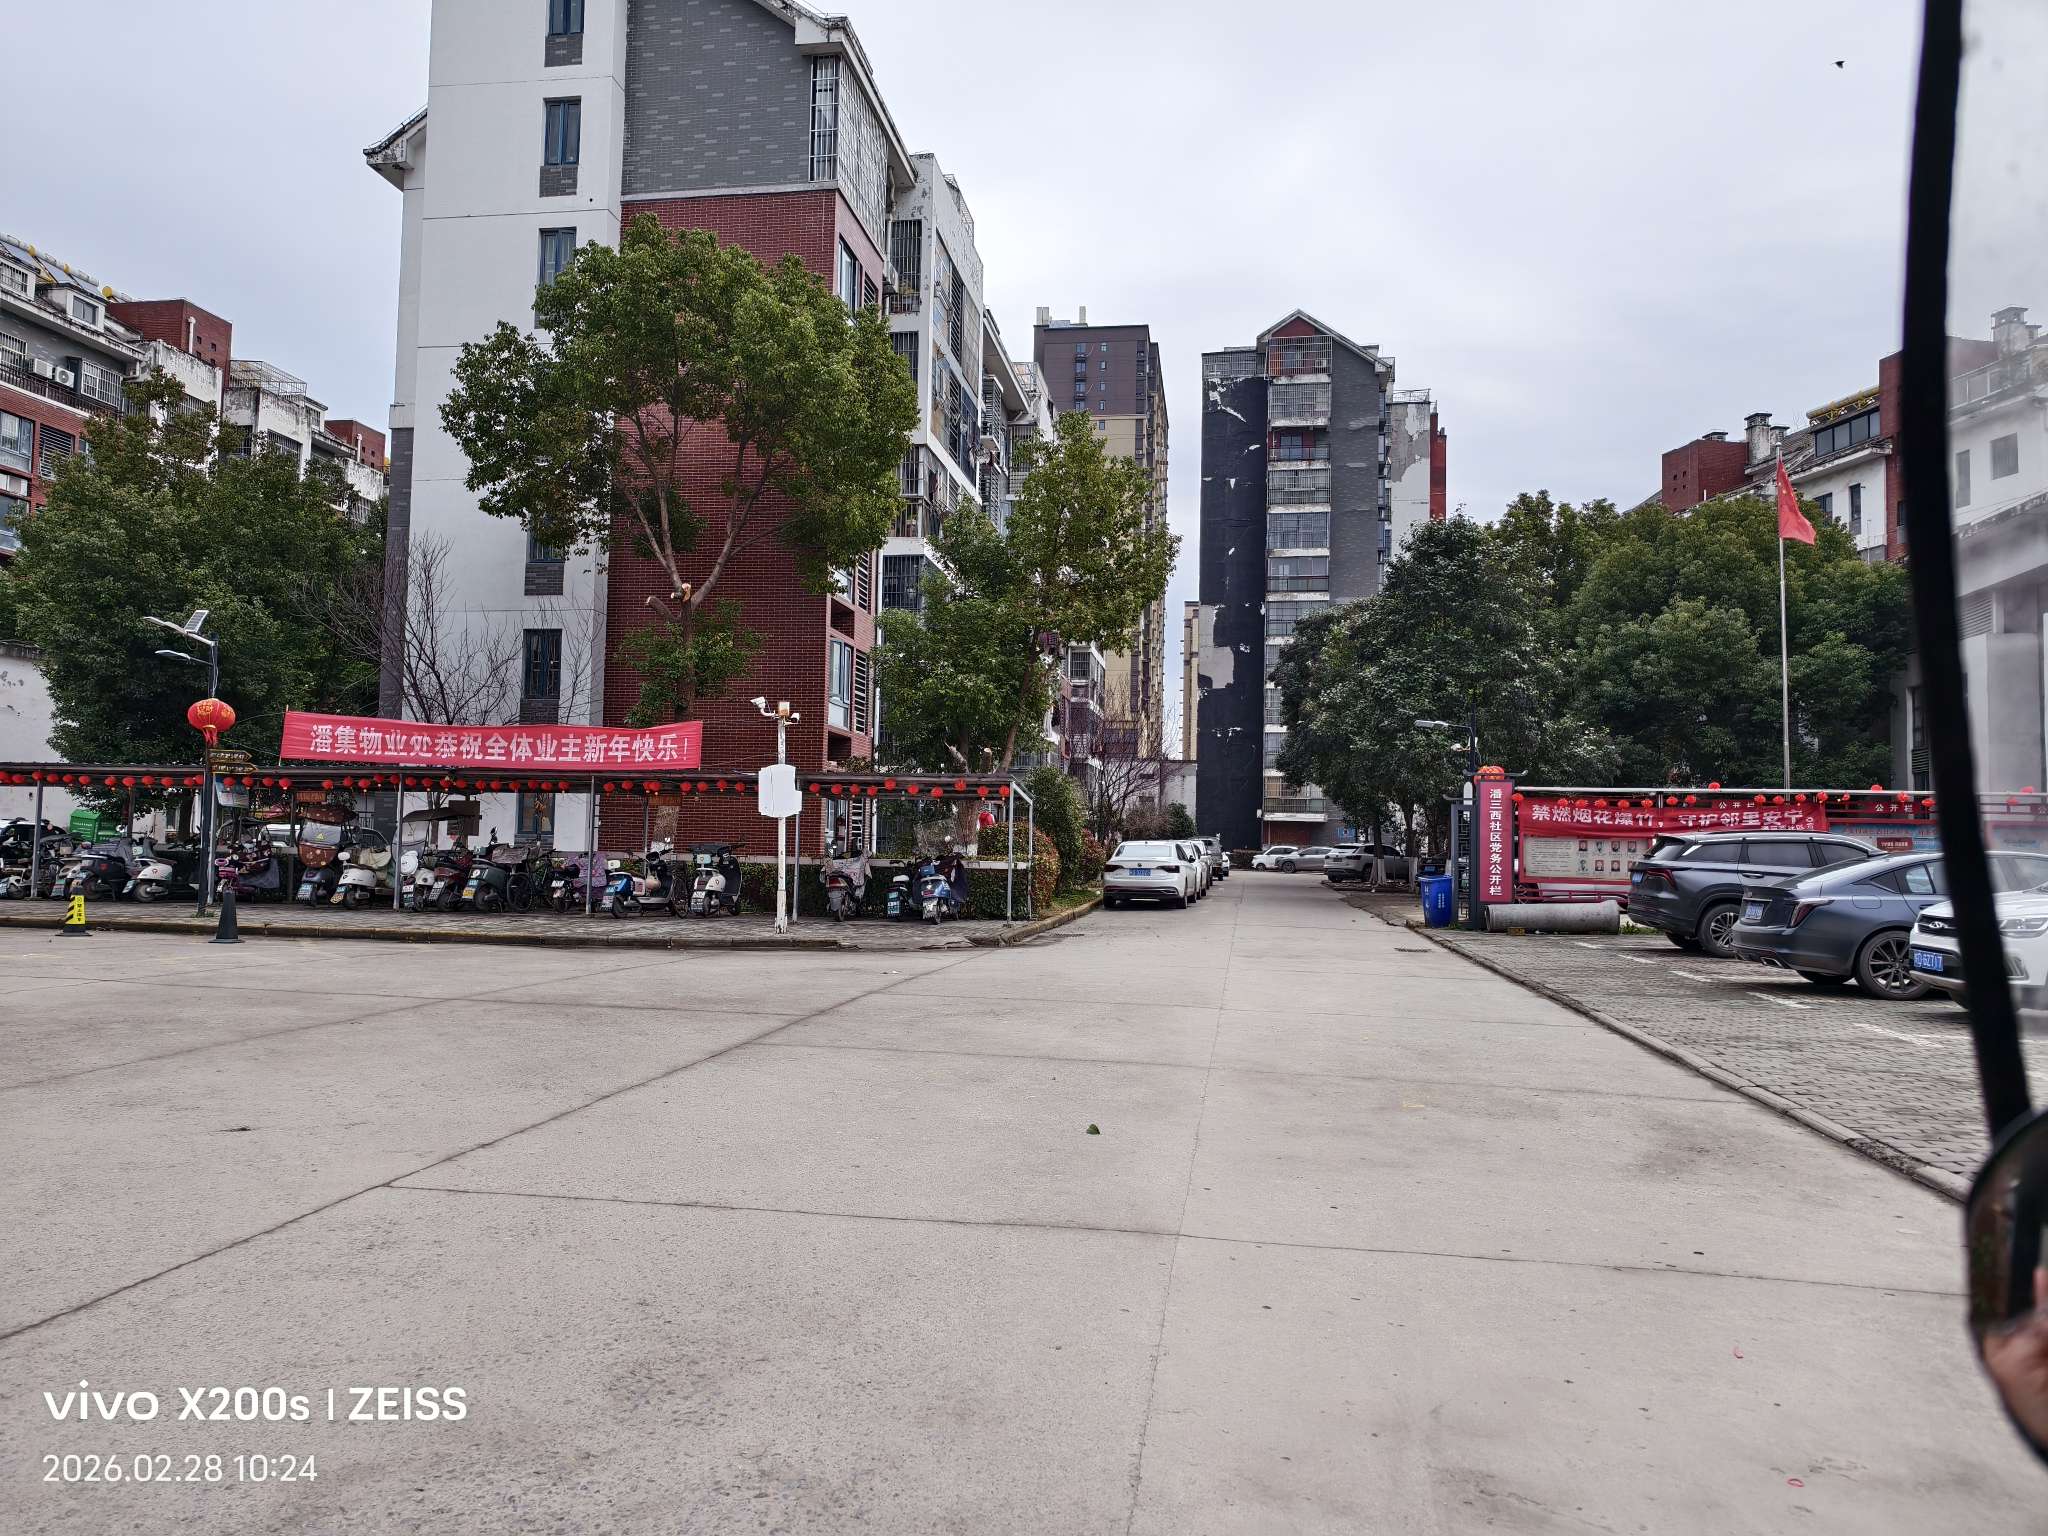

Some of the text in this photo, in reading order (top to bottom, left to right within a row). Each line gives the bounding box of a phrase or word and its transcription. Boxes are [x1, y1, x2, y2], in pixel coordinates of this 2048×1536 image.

[1489, 788, 1503, 896] 潘三西社区党务公开栏
